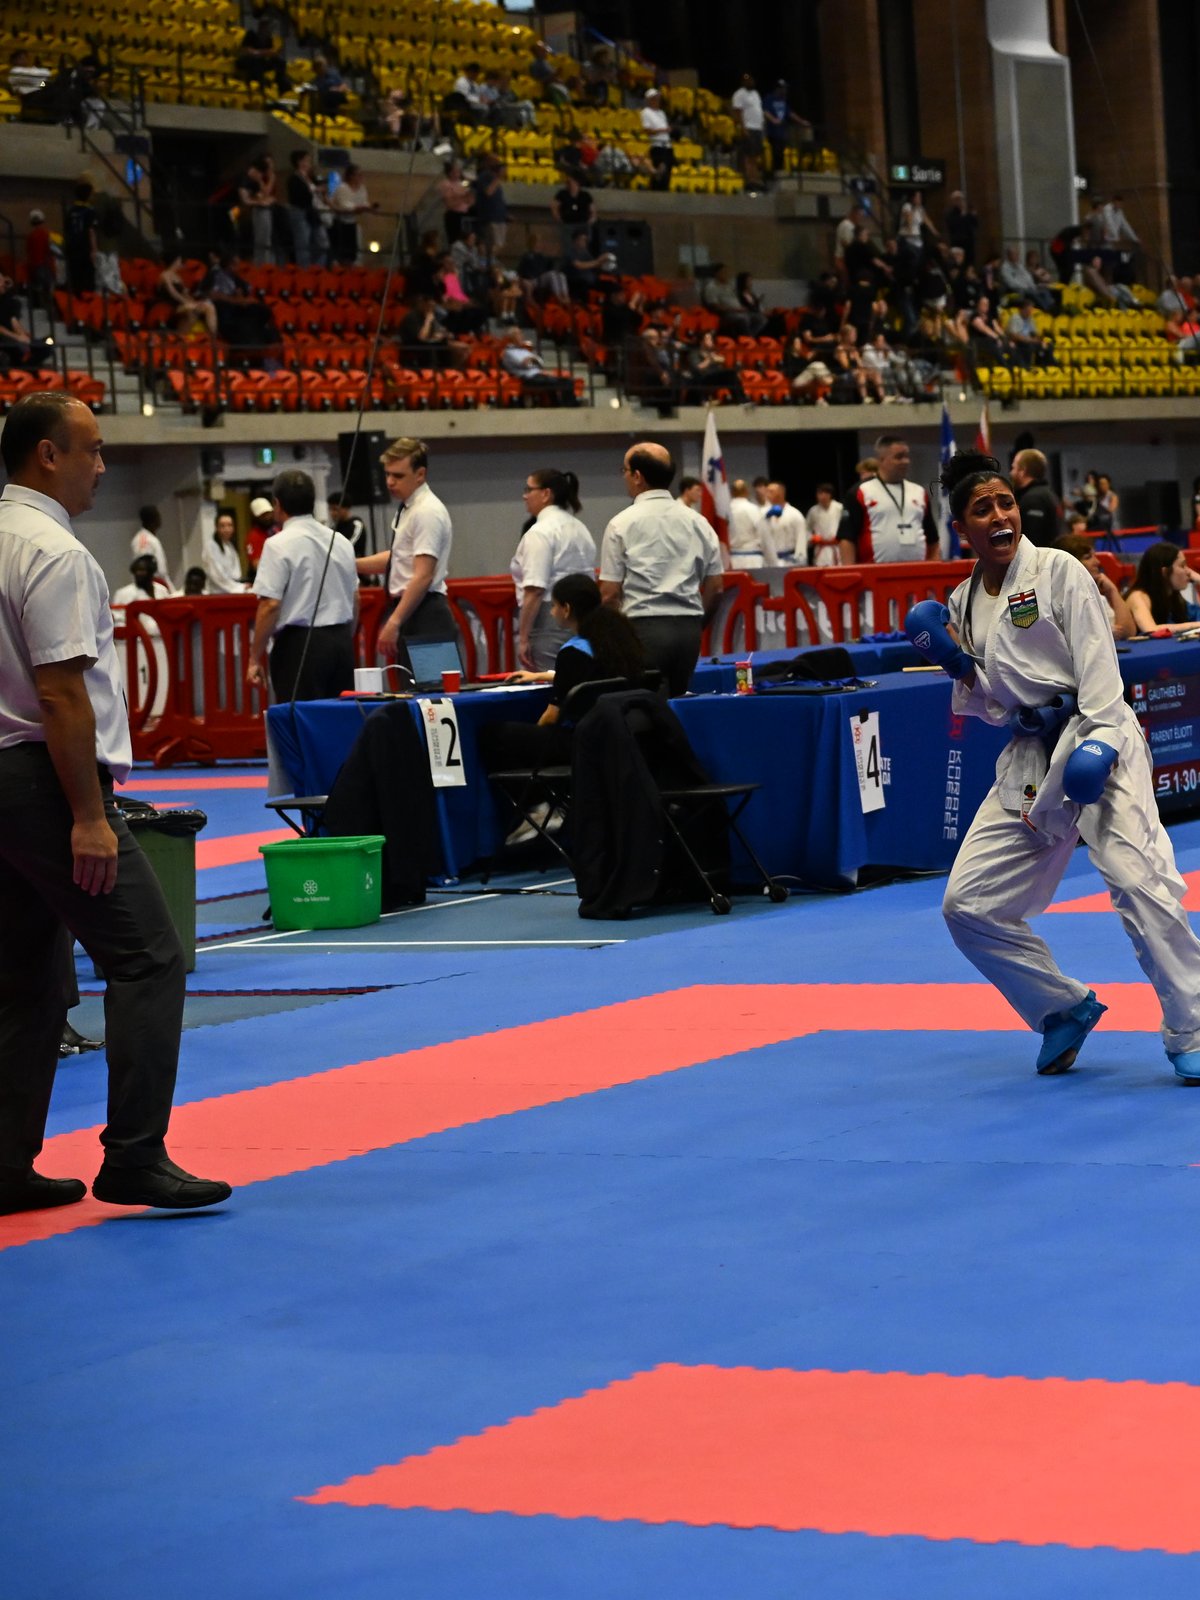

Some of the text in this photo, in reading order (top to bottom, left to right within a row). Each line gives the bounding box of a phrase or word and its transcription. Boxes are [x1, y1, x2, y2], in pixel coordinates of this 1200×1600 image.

[1132, 701, 1147, 713] CAN
[440, 717, 461, 767] 2
[866, 735, 880, 788] 4
